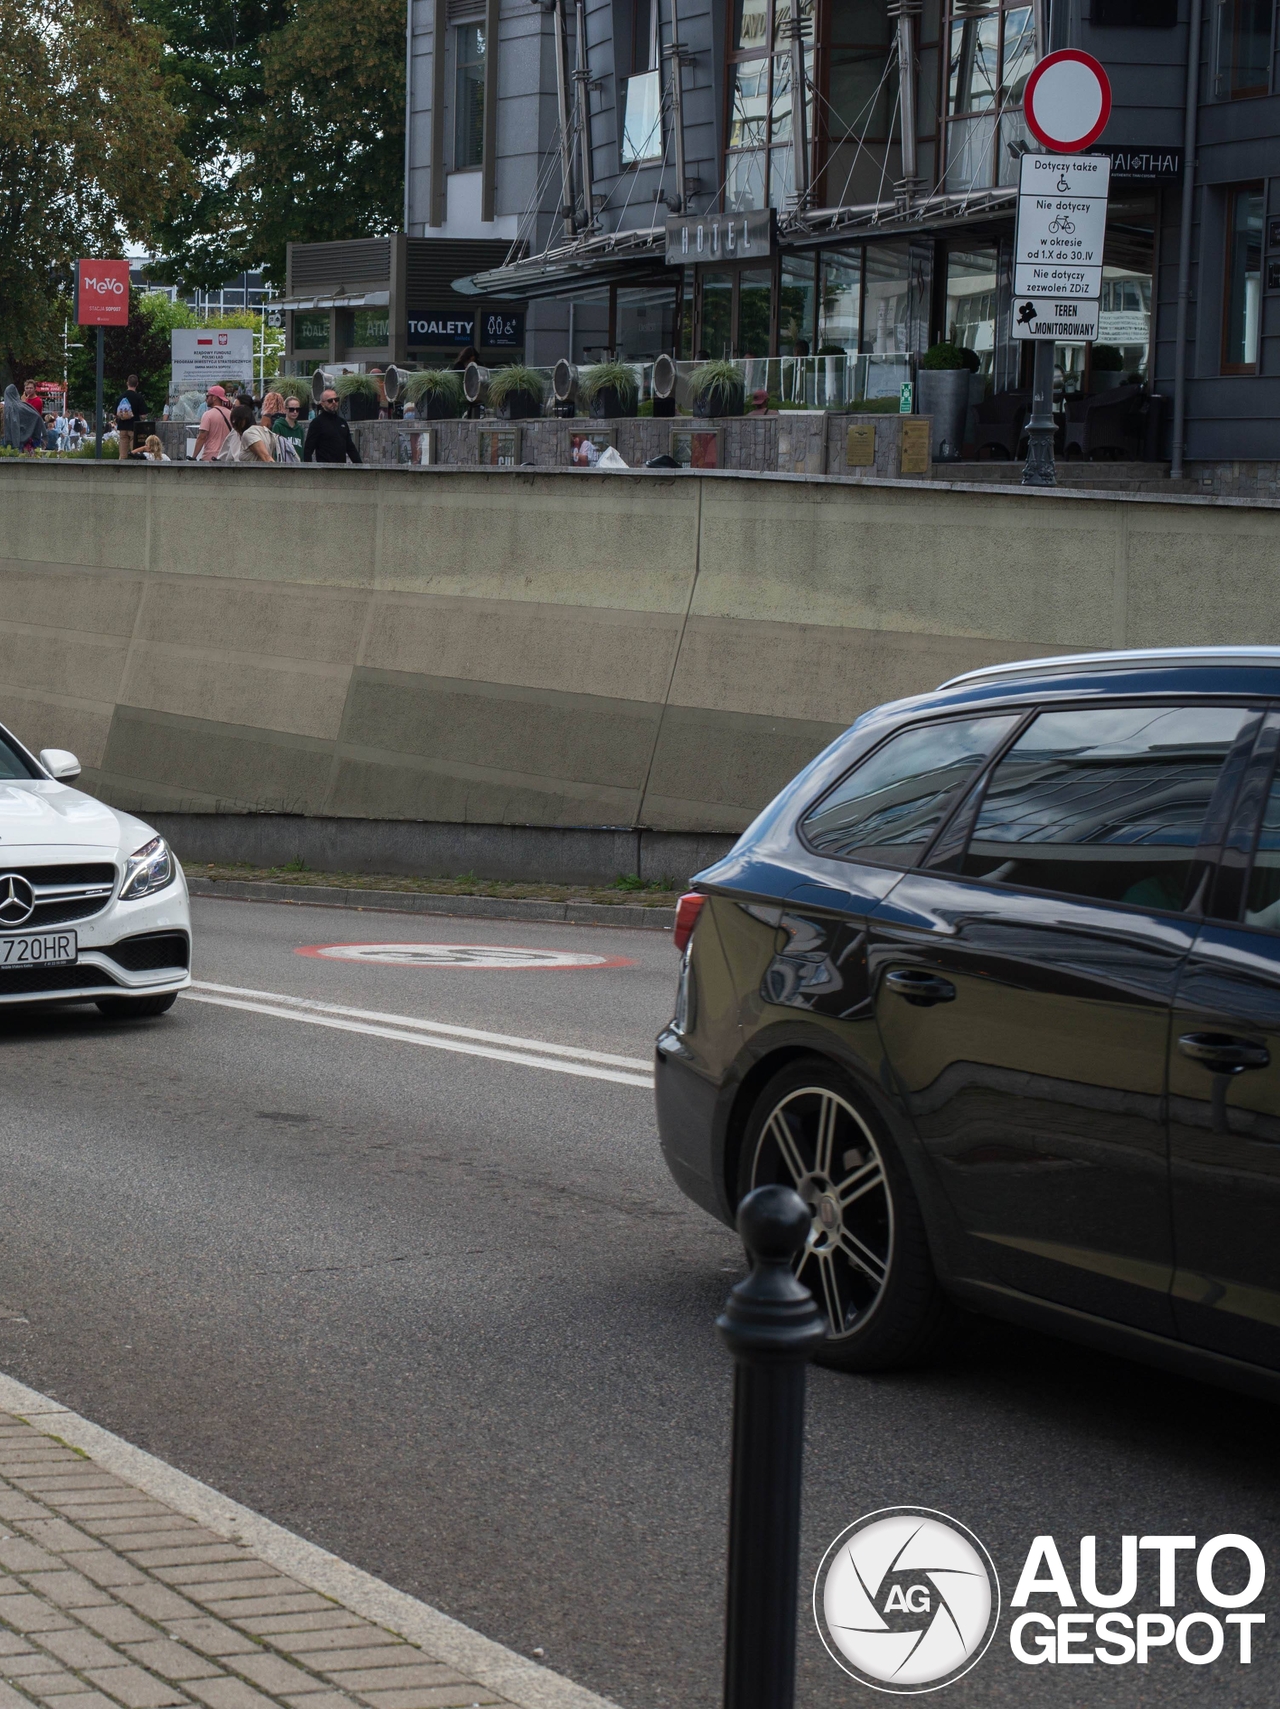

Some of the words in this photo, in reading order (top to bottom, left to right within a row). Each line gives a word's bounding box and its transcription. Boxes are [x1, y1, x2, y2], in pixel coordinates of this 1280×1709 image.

[1034, 160, 1071, 173] Dotyczy
[1073, 161, 1098, 172] także
[1139, 154, 1179, 172] THAI
[1036, 200, 1052, 210] Nie
[1056, 201, 1091, 213] dotyczy
[682, 220, 751, 254] HOTEL
[1049, 238, 1082, 247] okresie
[1027, 250, 1039, 259] od
[1041, 250, 1054, 259] 1.X
[1056, 251, 1068, 260] do
[1070, 251, 1094, 261] 30.IV
[1033, 269, 1049, 279] Nie
[1051, 270, 1085, 282] dotyczy
[1027, 283, 1067, 293] zezwoleń
[1069, 283, 1090, 293] ZDiZ
[1054, 304, 1078, 317] TEREN
[408, 320, 474, 334] TOALETY
[1034, 322, 1095, 336] MONITOROWANY
[3, 936, 70, 963] 720HR
